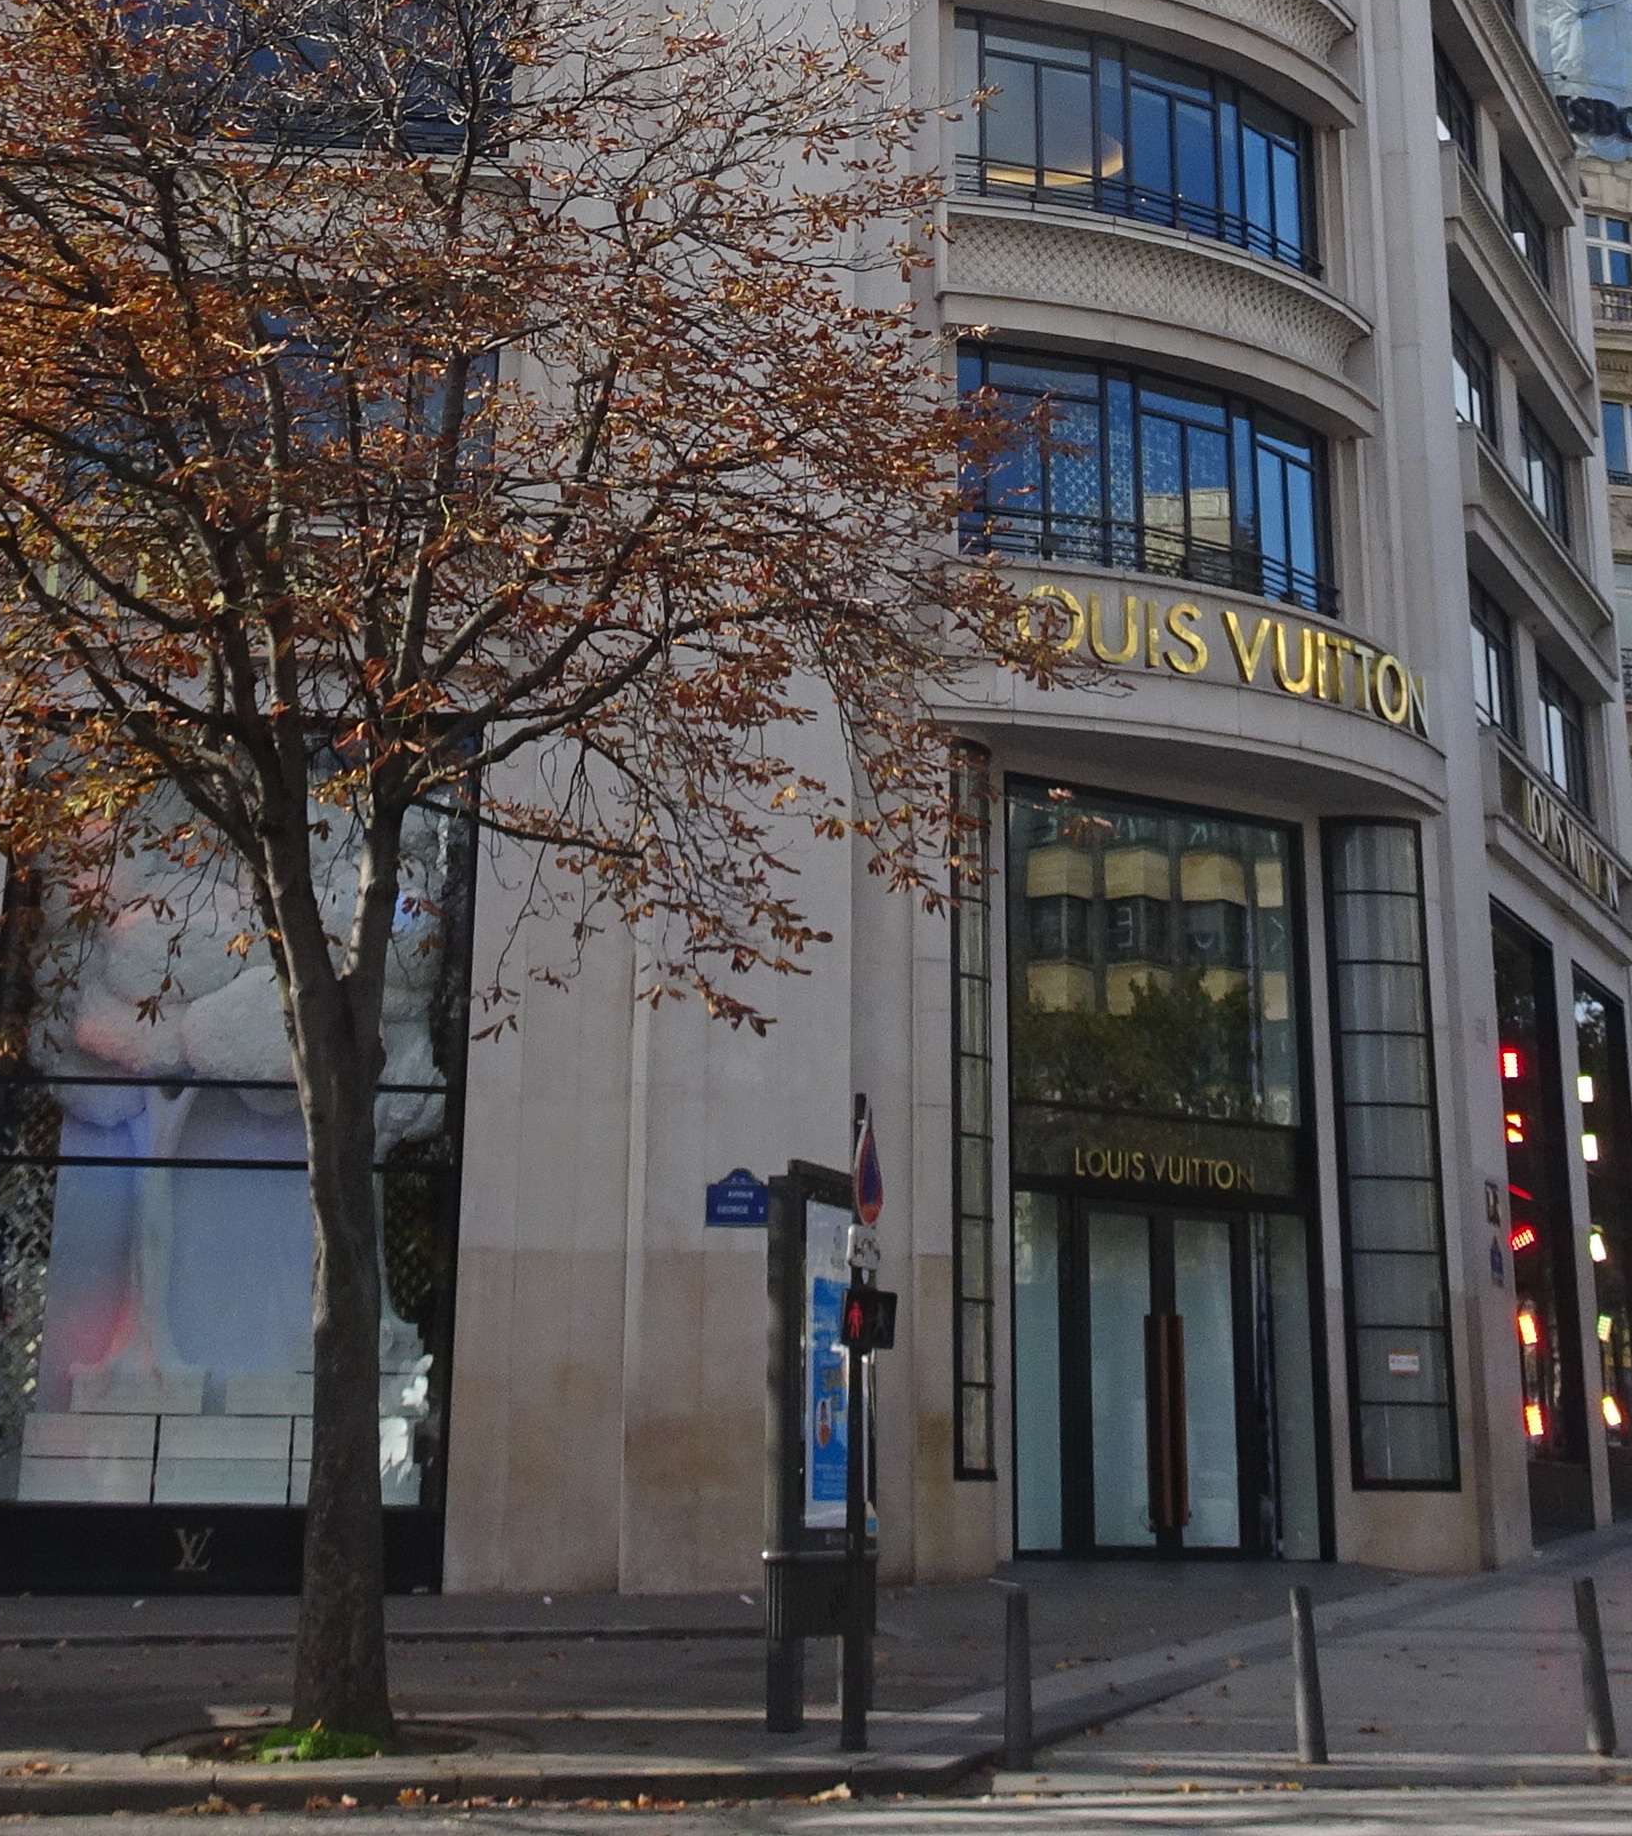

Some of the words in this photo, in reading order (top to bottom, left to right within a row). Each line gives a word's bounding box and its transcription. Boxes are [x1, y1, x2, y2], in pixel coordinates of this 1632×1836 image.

[1015, 584, 1210, 675] OUIS
[1221, 610, 1430, 740] VUITTON
[1074, 1146, 1147, 1183] LOUIS
[1150, 1153, 1255, 1193] VUITTON
